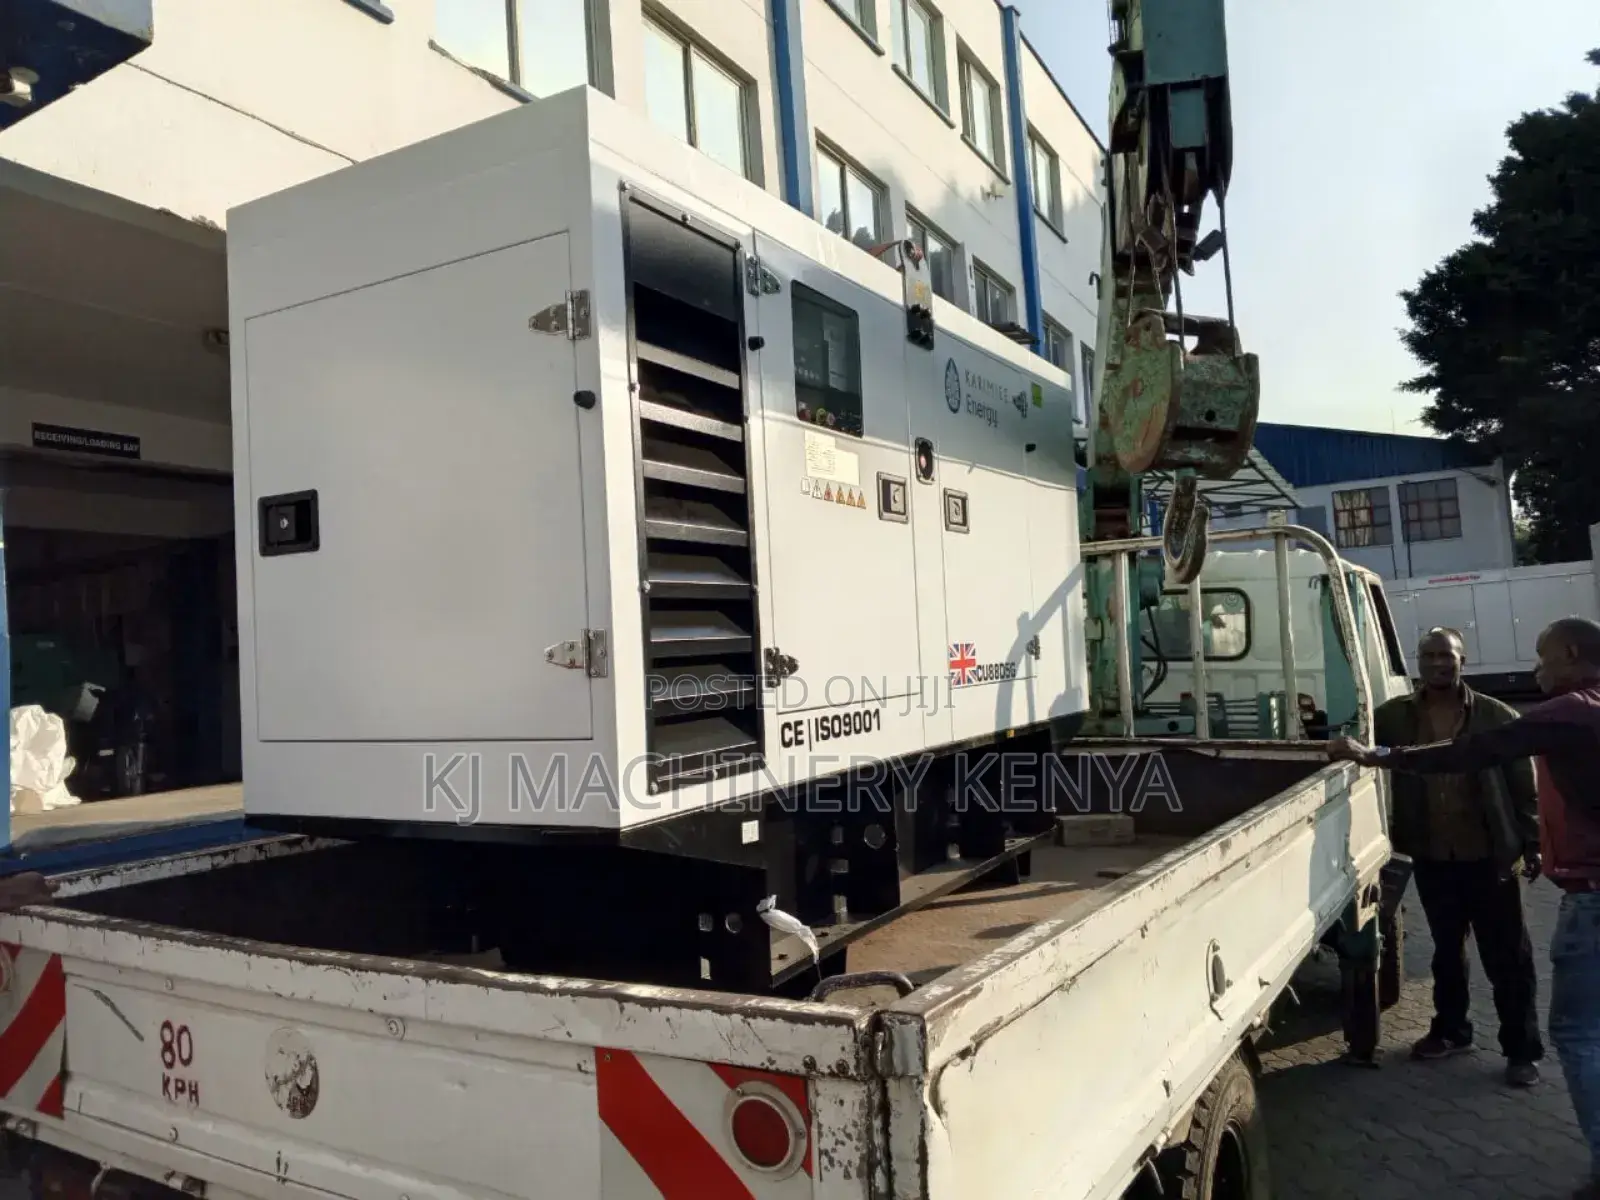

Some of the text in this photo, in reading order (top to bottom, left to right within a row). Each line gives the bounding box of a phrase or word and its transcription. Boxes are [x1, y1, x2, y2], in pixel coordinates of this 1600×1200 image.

[967, 394, 998, 428] Energy
[123, 442, 140, 452] BAY
[781, 721, 804, 747] CE
[815, 709, 881, 742] ISO9001
[160, 1020, 193, 1069] 80
[162, 1072, 199, 1106] KPH
